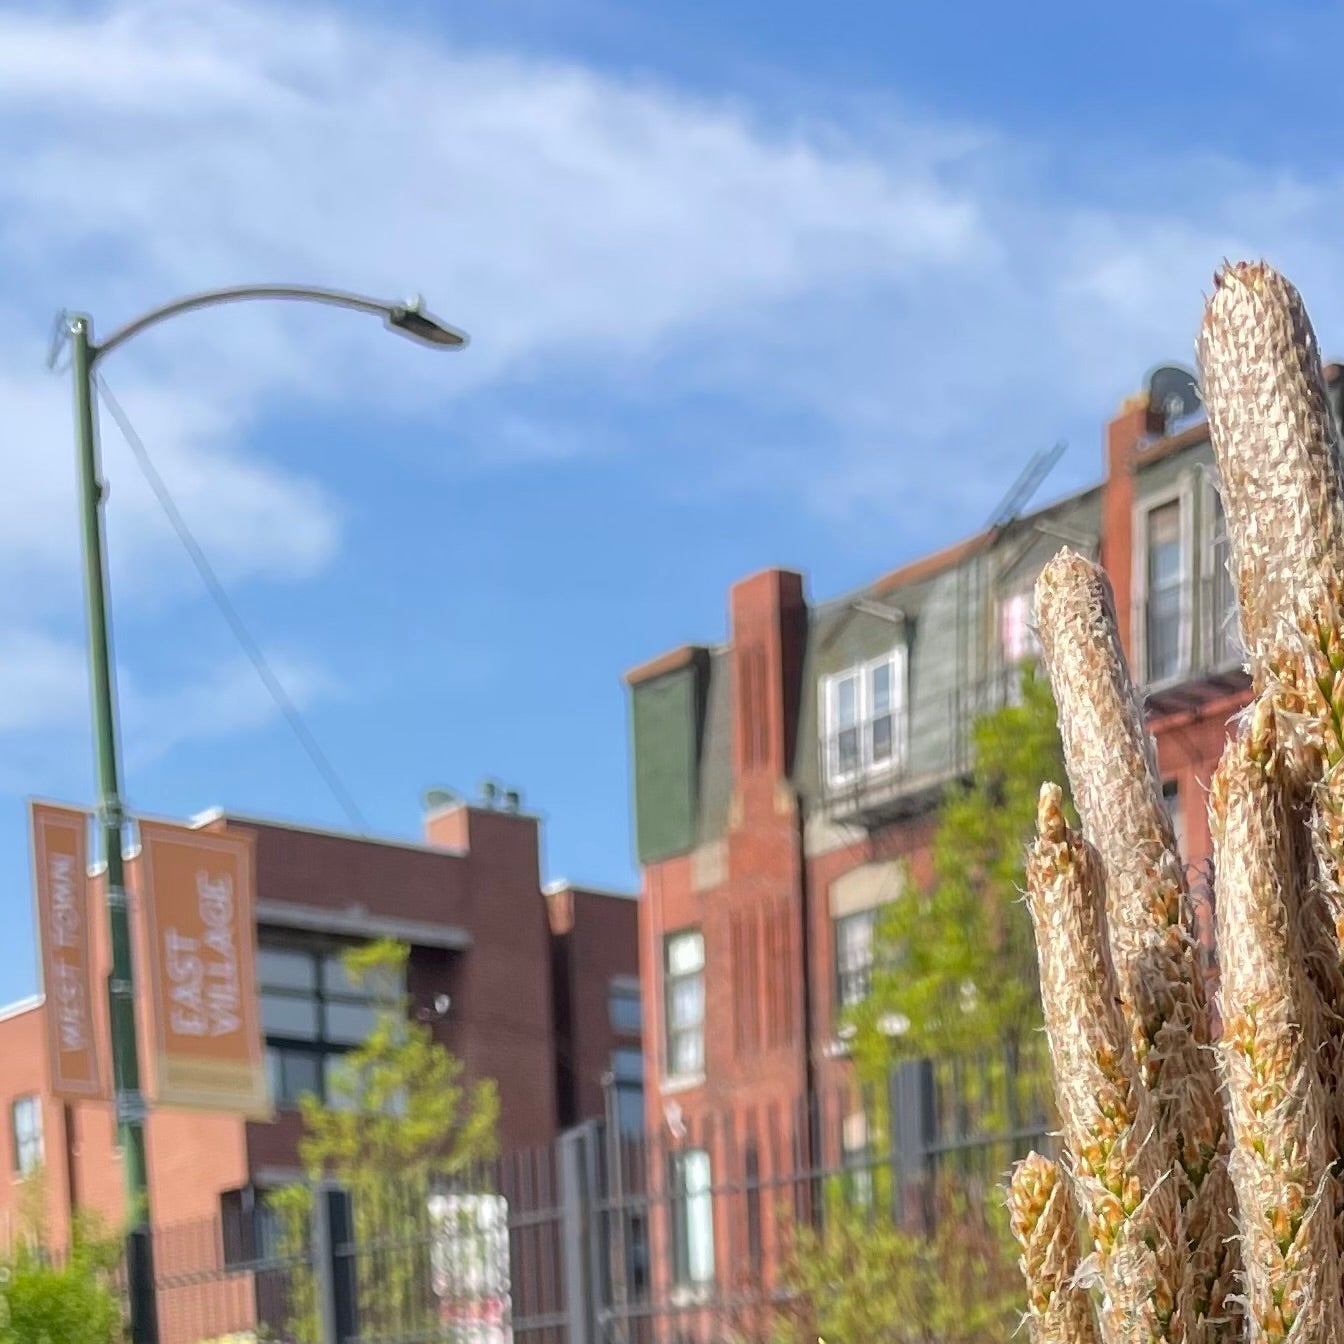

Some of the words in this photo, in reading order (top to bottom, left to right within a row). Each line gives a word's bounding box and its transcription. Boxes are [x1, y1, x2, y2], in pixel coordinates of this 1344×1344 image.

[50, 855, 80, 947] TOWN
[197, 872, 240, 1036] VILLAGE
[165, 929, 207, 1036] EAST
